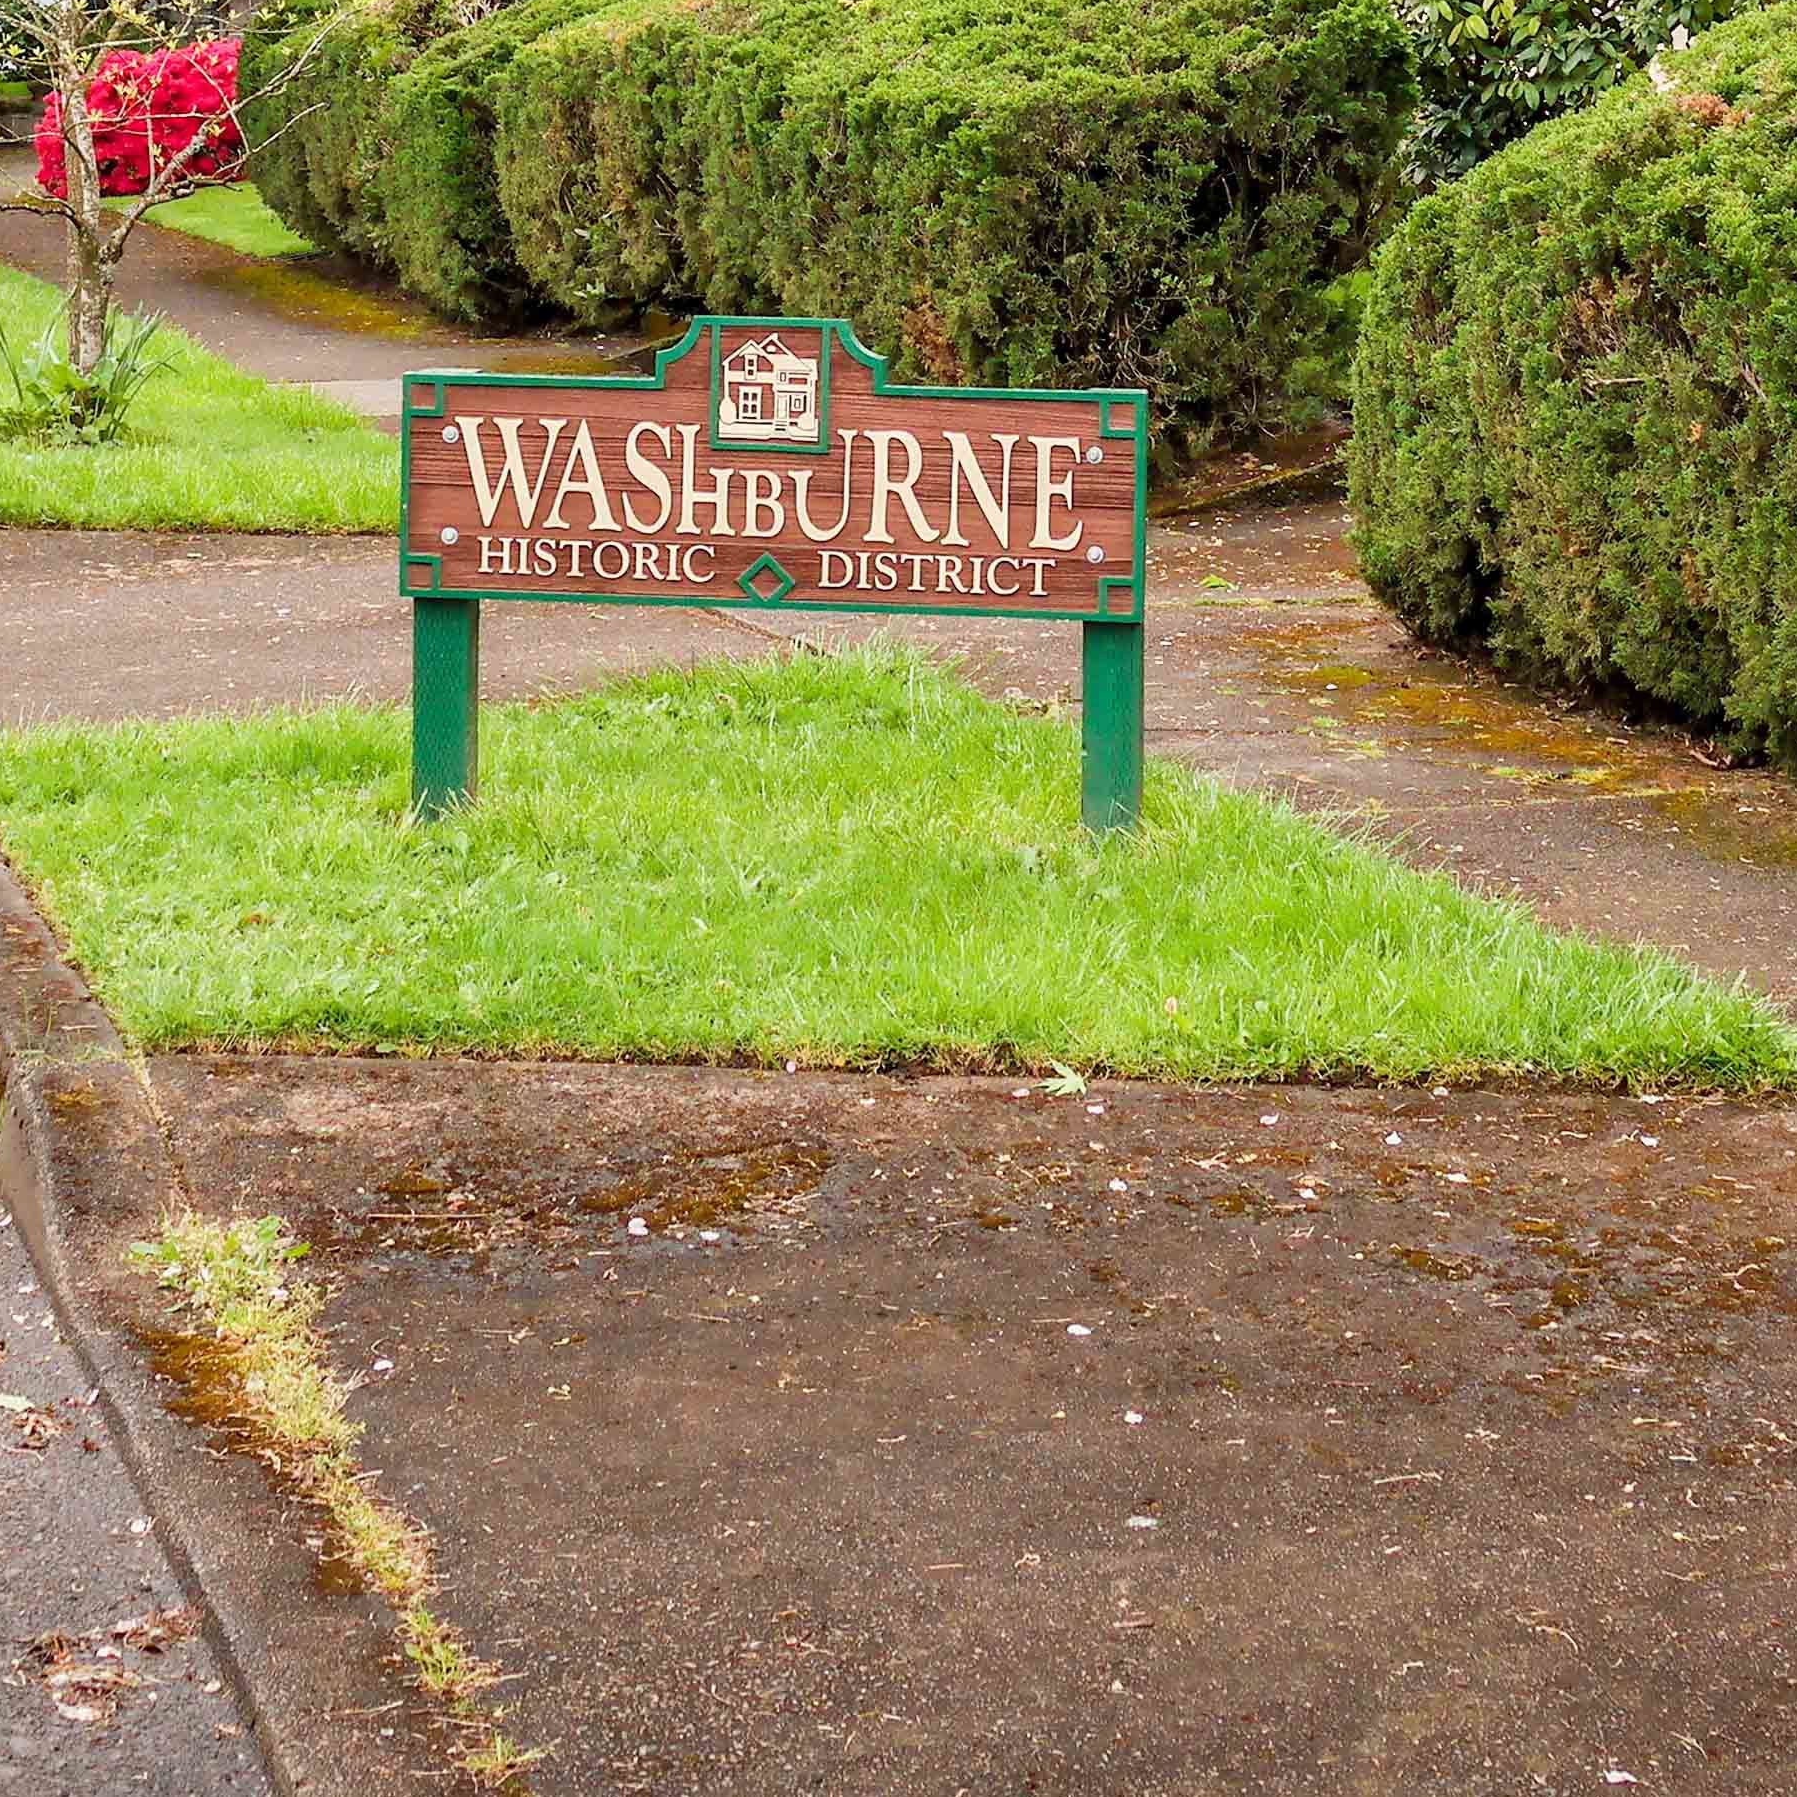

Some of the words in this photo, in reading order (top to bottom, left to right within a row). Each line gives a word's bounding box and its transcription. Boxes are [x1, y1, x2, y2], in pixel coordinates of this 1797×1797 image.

[454, 415, 1085, 553] WASHBURNE
[477, 537, 716, 584] HISTORIC
[817, 549, 1057, 597] DISTRICT
